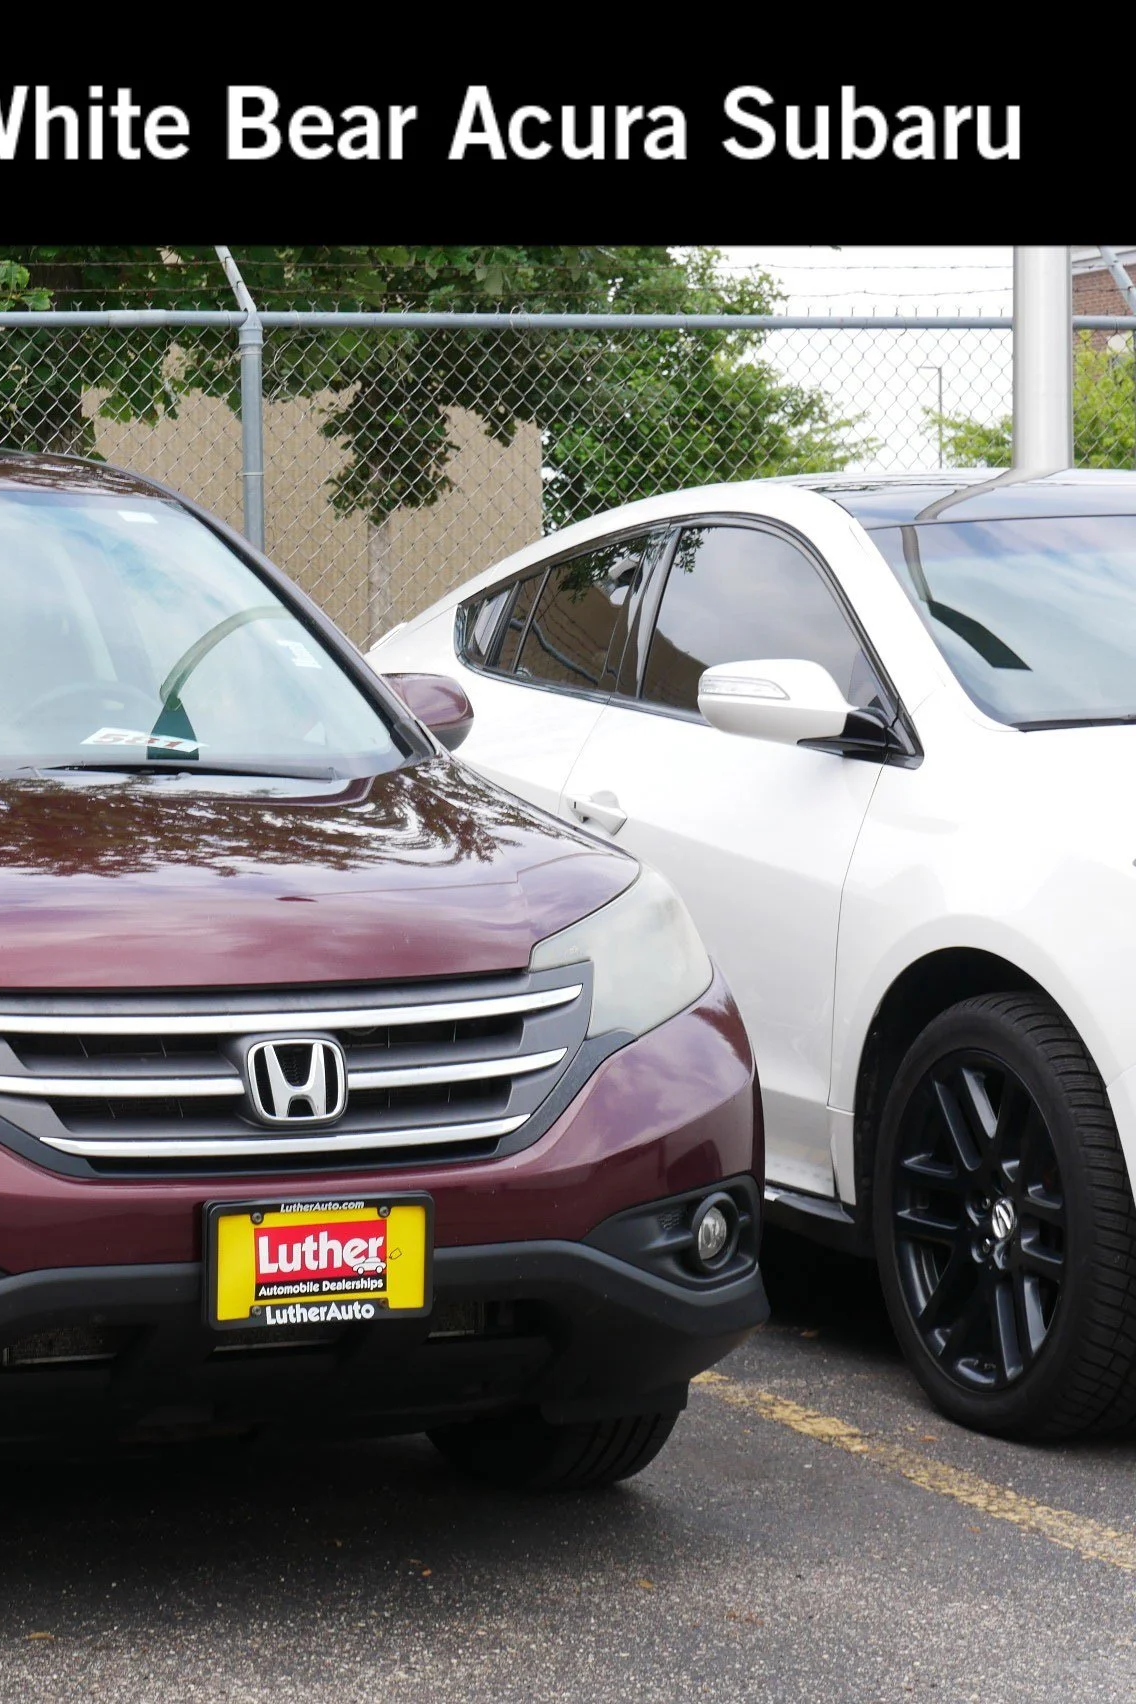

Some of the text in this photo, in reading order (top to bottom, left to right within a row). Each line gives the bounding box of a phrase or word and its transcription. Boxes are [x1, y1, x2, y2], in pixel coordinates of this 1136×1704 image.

[280, 1201, 364, 1212] LutherAuto.com
[258, 1231, 384, 1274] Luther
[259, 1277, 383, 1296] Automobile Dealerships
[266, 1302, 375, 1325] LutherAuto
